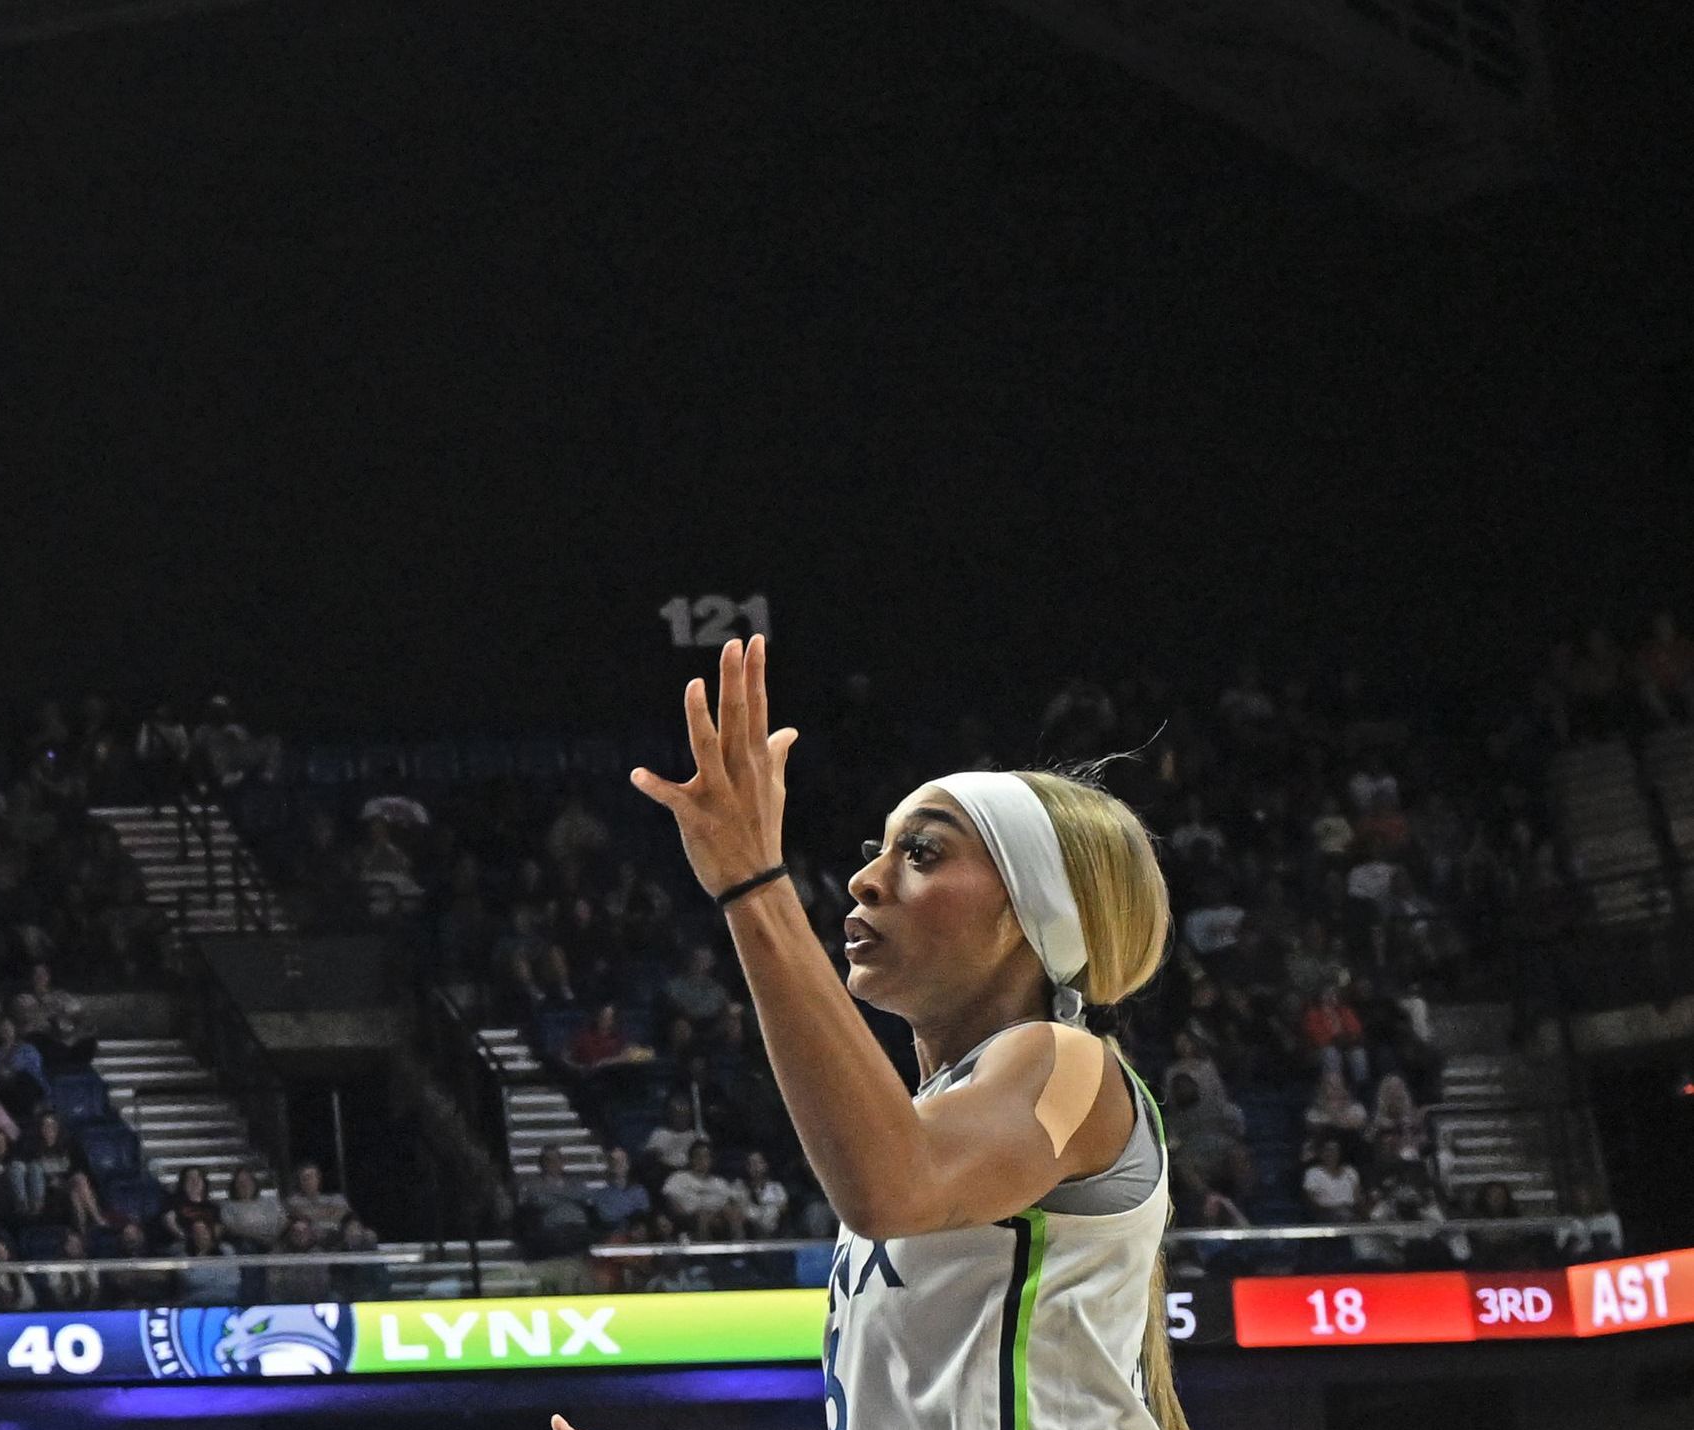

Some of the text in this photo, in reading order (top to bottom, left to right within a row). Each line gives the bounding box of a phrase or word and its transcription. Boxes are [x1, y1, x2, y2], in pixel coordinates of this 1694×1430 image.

[661, 596, 770, 646] 121
[1306, 1287, 1367, 1335] 18
[1475, 1287, 1552, 1325] 3RD
[1591, 1260, 1670, 1327] AST
[7, 1322, 104, 1374] 40
[380, 1307, 622, 1361] LYNX
